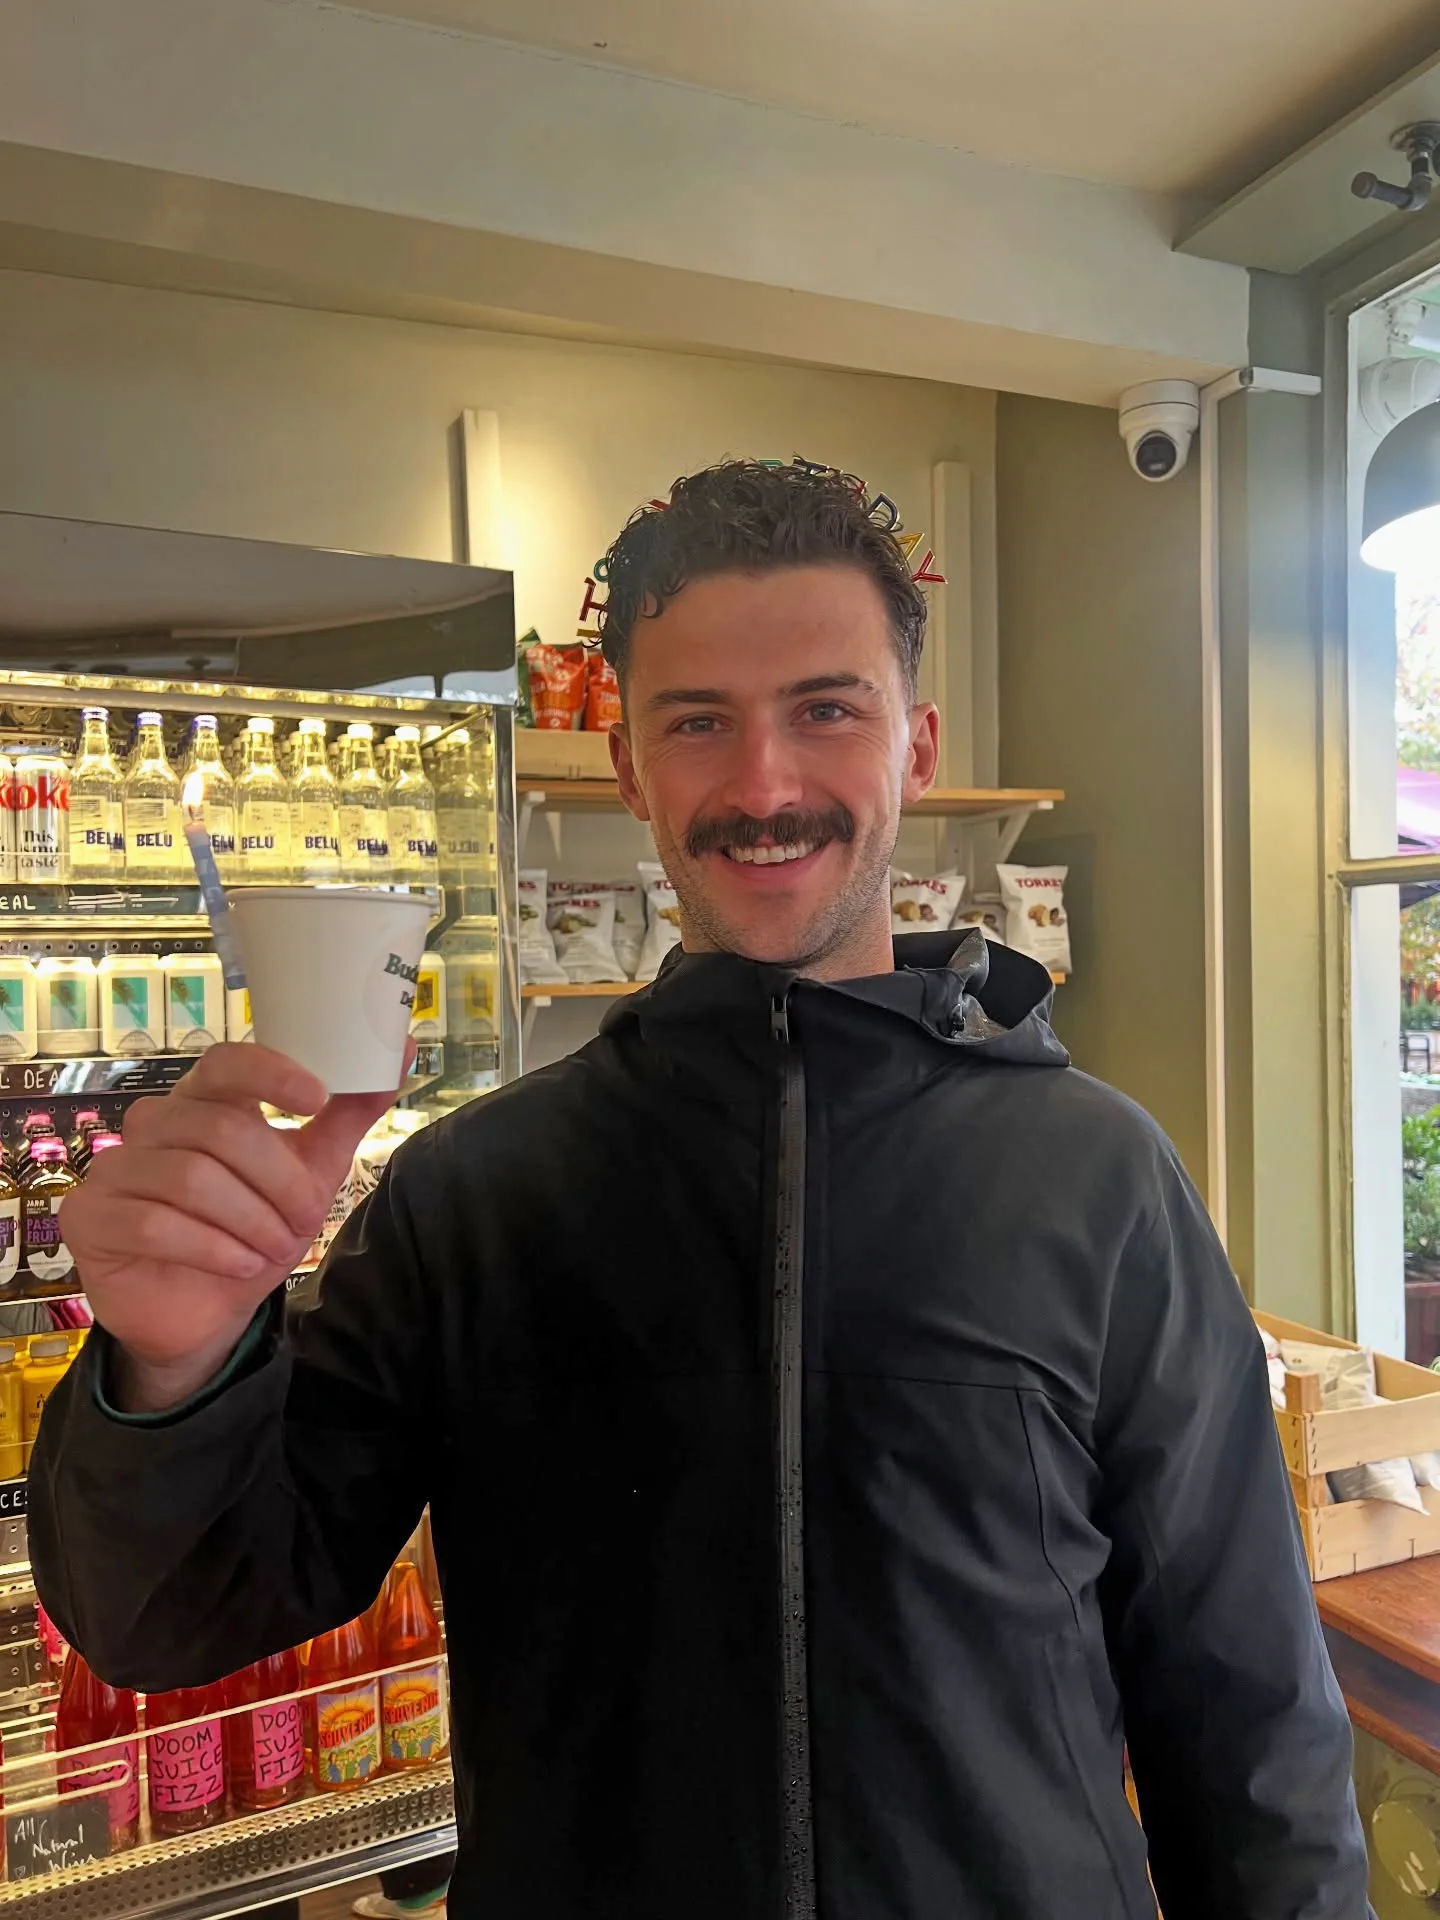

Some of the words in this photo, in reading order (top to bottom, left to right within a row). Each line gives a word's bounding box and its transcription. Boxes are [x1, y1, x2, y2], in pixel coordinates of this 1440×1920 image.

[136, 833, 172, 847] BELU
[241, 836, 274, 850] BELU
[305, 836, 341, 857] BELU
[153, 1726, 213, 1755] DOOM
[152, 1743, 222, 1780] JUICE
[153, 1774, 222, 1805] FIZZ
[14, 1817, 35, 1844] All
